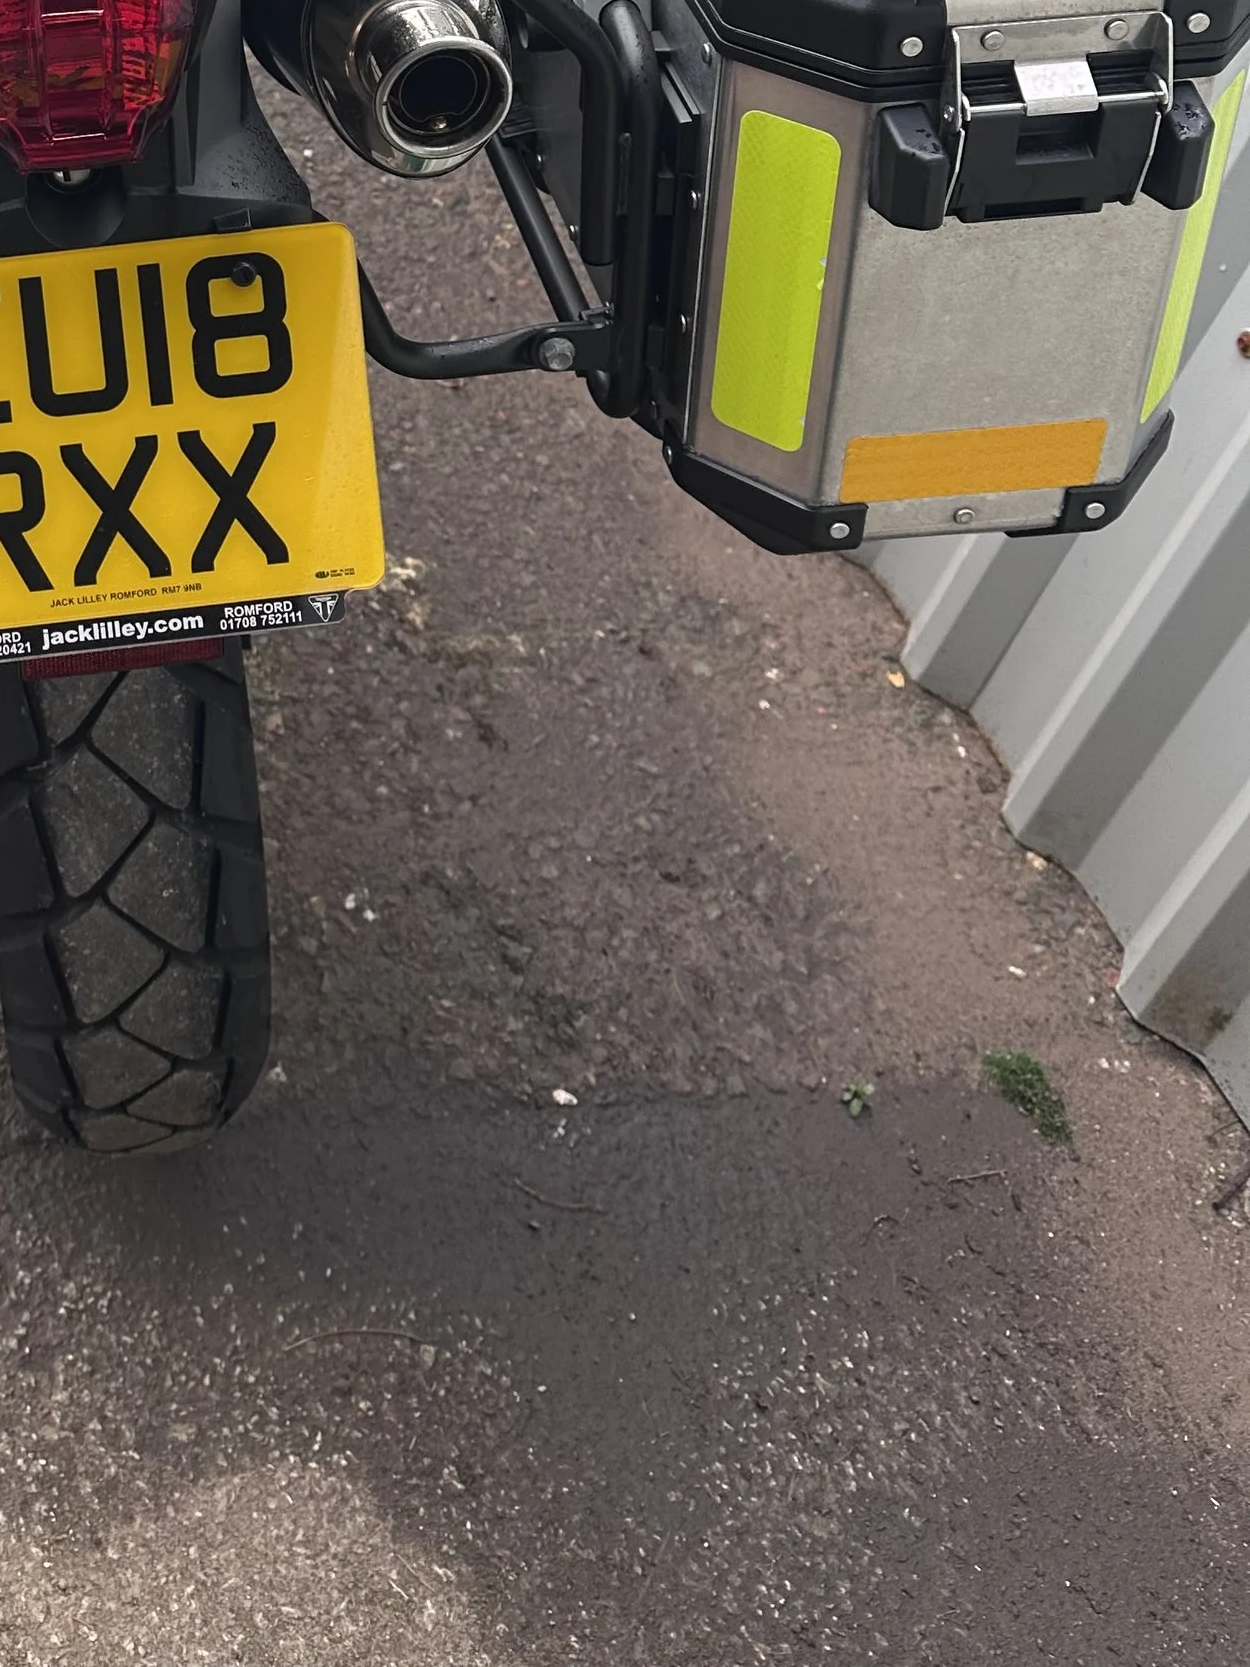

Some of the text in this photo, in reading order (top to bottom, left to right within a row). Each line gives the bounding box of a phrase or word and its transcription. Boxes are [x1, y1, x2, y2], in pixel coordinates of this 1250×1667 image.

[50, 598, 75, 608] JACK
[77, 594, 108, 605] LILLEY
[110, 588, 158, 601] ROMFORD
[162, 585, 181, 595] RM7
[219, 610, 303, 631] 01708 752111
[224, 600, 293, 619] ROMFORD
[42, 614, 204, 651] jacklilley.com
